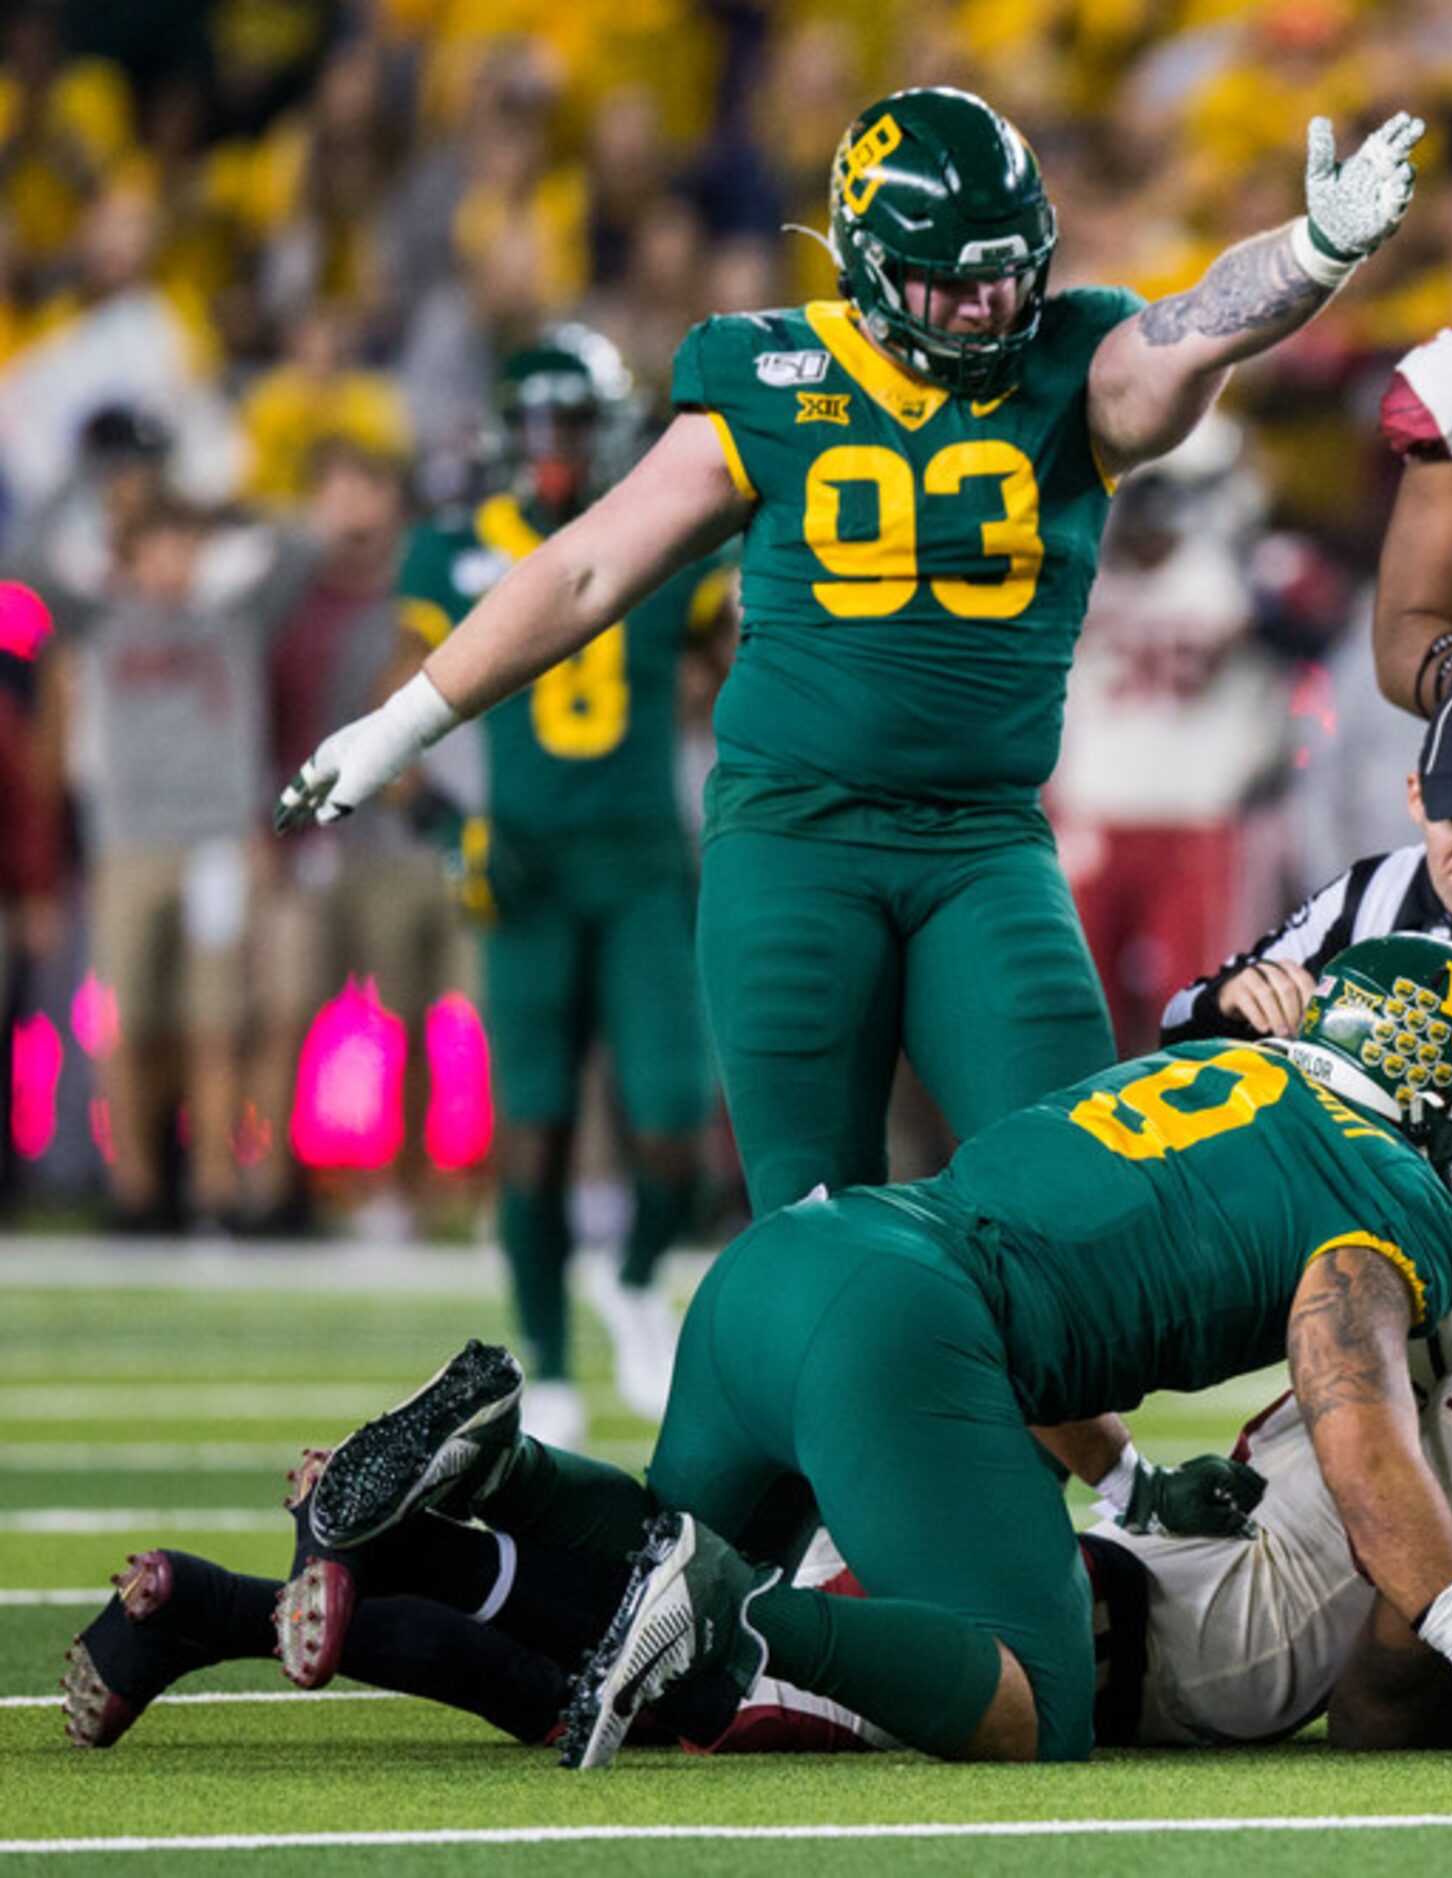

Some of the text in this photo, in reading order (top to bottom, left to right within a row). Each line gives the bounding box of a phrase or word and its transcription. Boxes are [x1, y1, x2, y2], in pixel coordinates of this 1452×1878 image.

[799, 395, 847, 421] XII
[803, 439, 1045, 618] 93
[1068, 1048, 1290, 1160] 9
